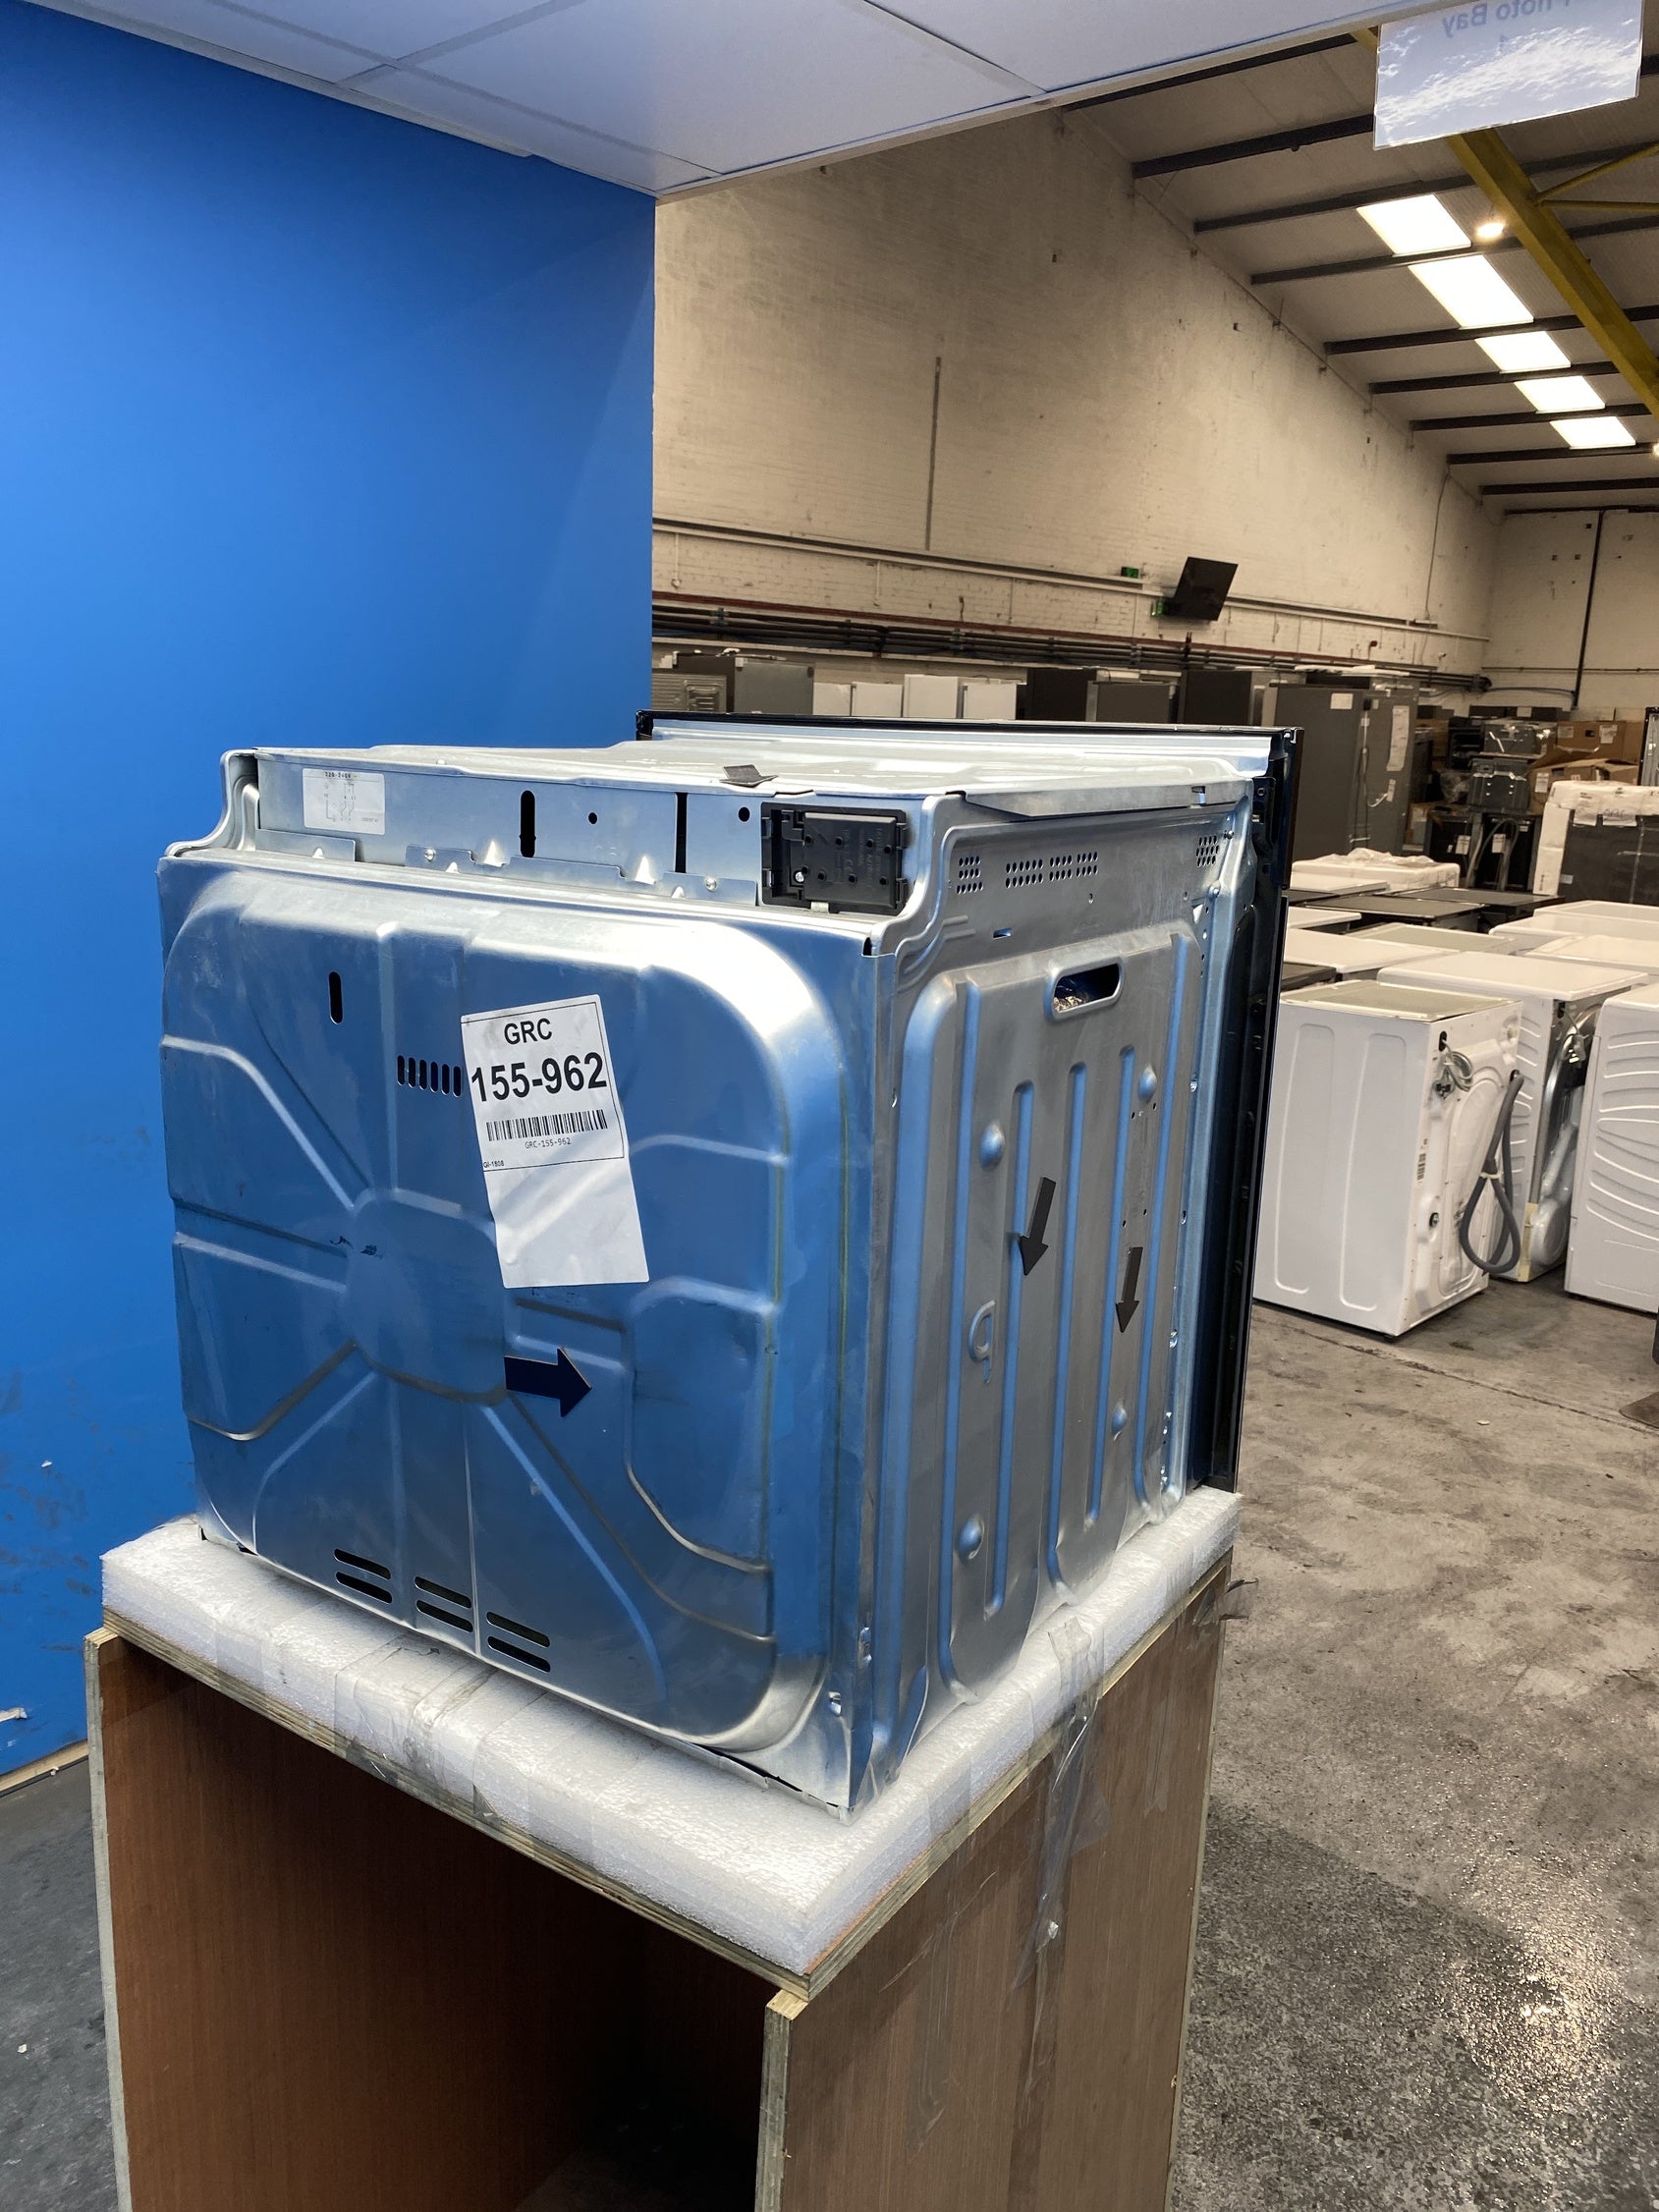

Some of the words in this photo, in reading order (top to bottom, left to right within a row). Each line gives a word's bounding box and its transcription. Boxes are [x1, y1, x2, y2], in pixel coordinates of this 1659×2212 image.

[504, 1019, 552, 1045] GRC
[471, 1052, 608, 1102] 155-962
[525, 1136, 572, 1149] GRC-155-962
